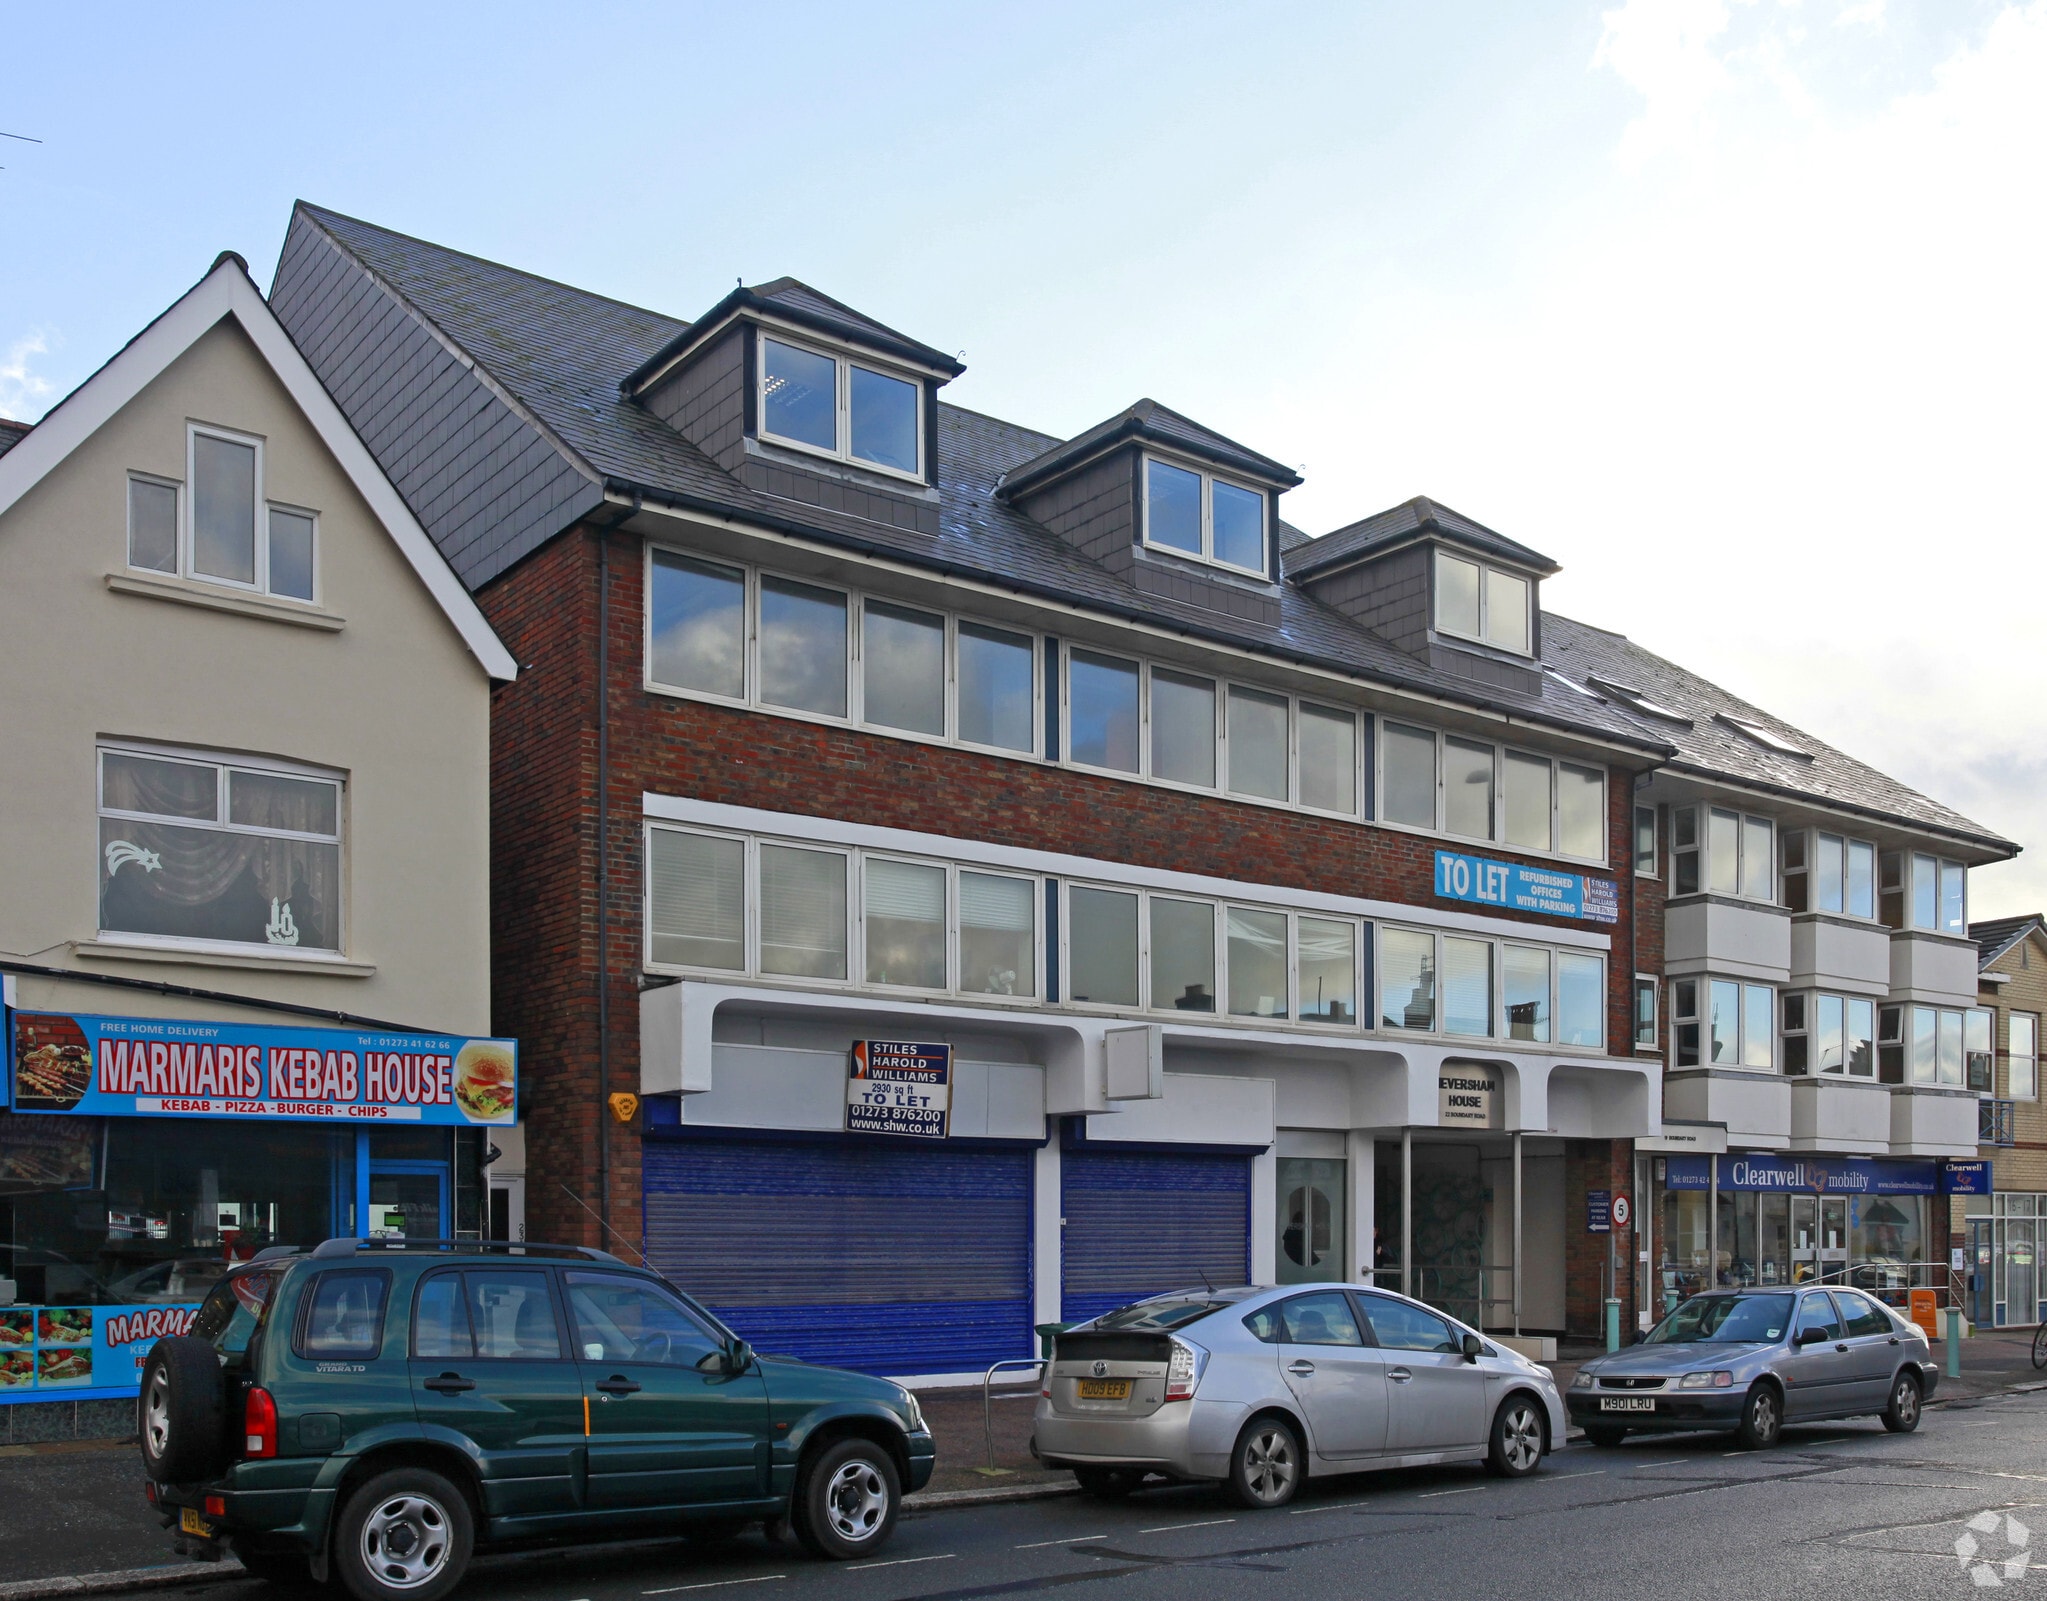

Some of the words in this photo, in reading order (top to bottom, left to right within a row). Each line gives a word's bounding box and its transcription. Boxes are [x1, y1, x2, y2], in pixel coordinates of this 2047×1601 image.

[1441, 856, 1469, 896] TO
[1476, 862, 1509, 902] LET
[1519, 870, 1573, 888] REFURBISHED
[1591, 879, 1609, 888] STILES
[1530, 884, 1563, 900] OFFICES
[1591, 889, 1613, 898] HAROLD
[1516, 895, 1537, 908] WITH
[1539, 899, 1575, 914] PARKING
[1591, 898, 1617, 908] WILLIAMS
[100, 1022, 127, 1032] FREE
[131, 1024, 164, 1034] HOME
[167, 1026, 219, 1037] DELIVERY
[358, 1036, 371, 1046] Tel
[379, 1038, 408, 1047] 01273
[410, 1040, 421, 1048] 41
[425, 1040, 437, 1049] 62
[439, 1041, 450, 1049] 66
[873, 1043, 918, 1055] STILES
[873, 1057, 927, 1069] HAROLD
[98, 1038, 262, 1099] MARMARIS
[268, 1047, 359, 1101] KEBAB
[365, 1051, 452, 1105] HOUSE
[872, 1069, 937, 1083] WILLIAMS
[872, 1083, 891, 1094] 2930
[894, 1085, 904, 1096] sq
[907, 1084, 914, 1094] ft
[1439, 1077, 1495, 1092] EVERSHAM
[862, 1093, 886, 1105] TO
[895, 1095, 931, 1108] LET
[1449, 1095, 1481, 1108] HOUSE
[161, 1099, 210, 1111] KEBAB
[225, 1101, 266, 1113] PIZZA
[348, 1105, 388, 1117] CHIPS
[852, 1105, 888, 1118] 01273
[892, 1108, 941, 1122] 876200
[851, 1119, 940, 1135] www.shw.co.uk
[1945, 1163, 1982, 1172] Clearwell
[1682, 1176, 1698, 1184] 01273
[1732, 1161, 1805, 1186] Clearwell
[1828, 1171, 1869, 1191] mobility
[1618, 1205, 1624, 1216] 5
[1081, 1382, 1105, 1395] HD09
[1107, 1382, 1126, 1395] EFB
[1630, 1398, 1651, 1409] LRU
